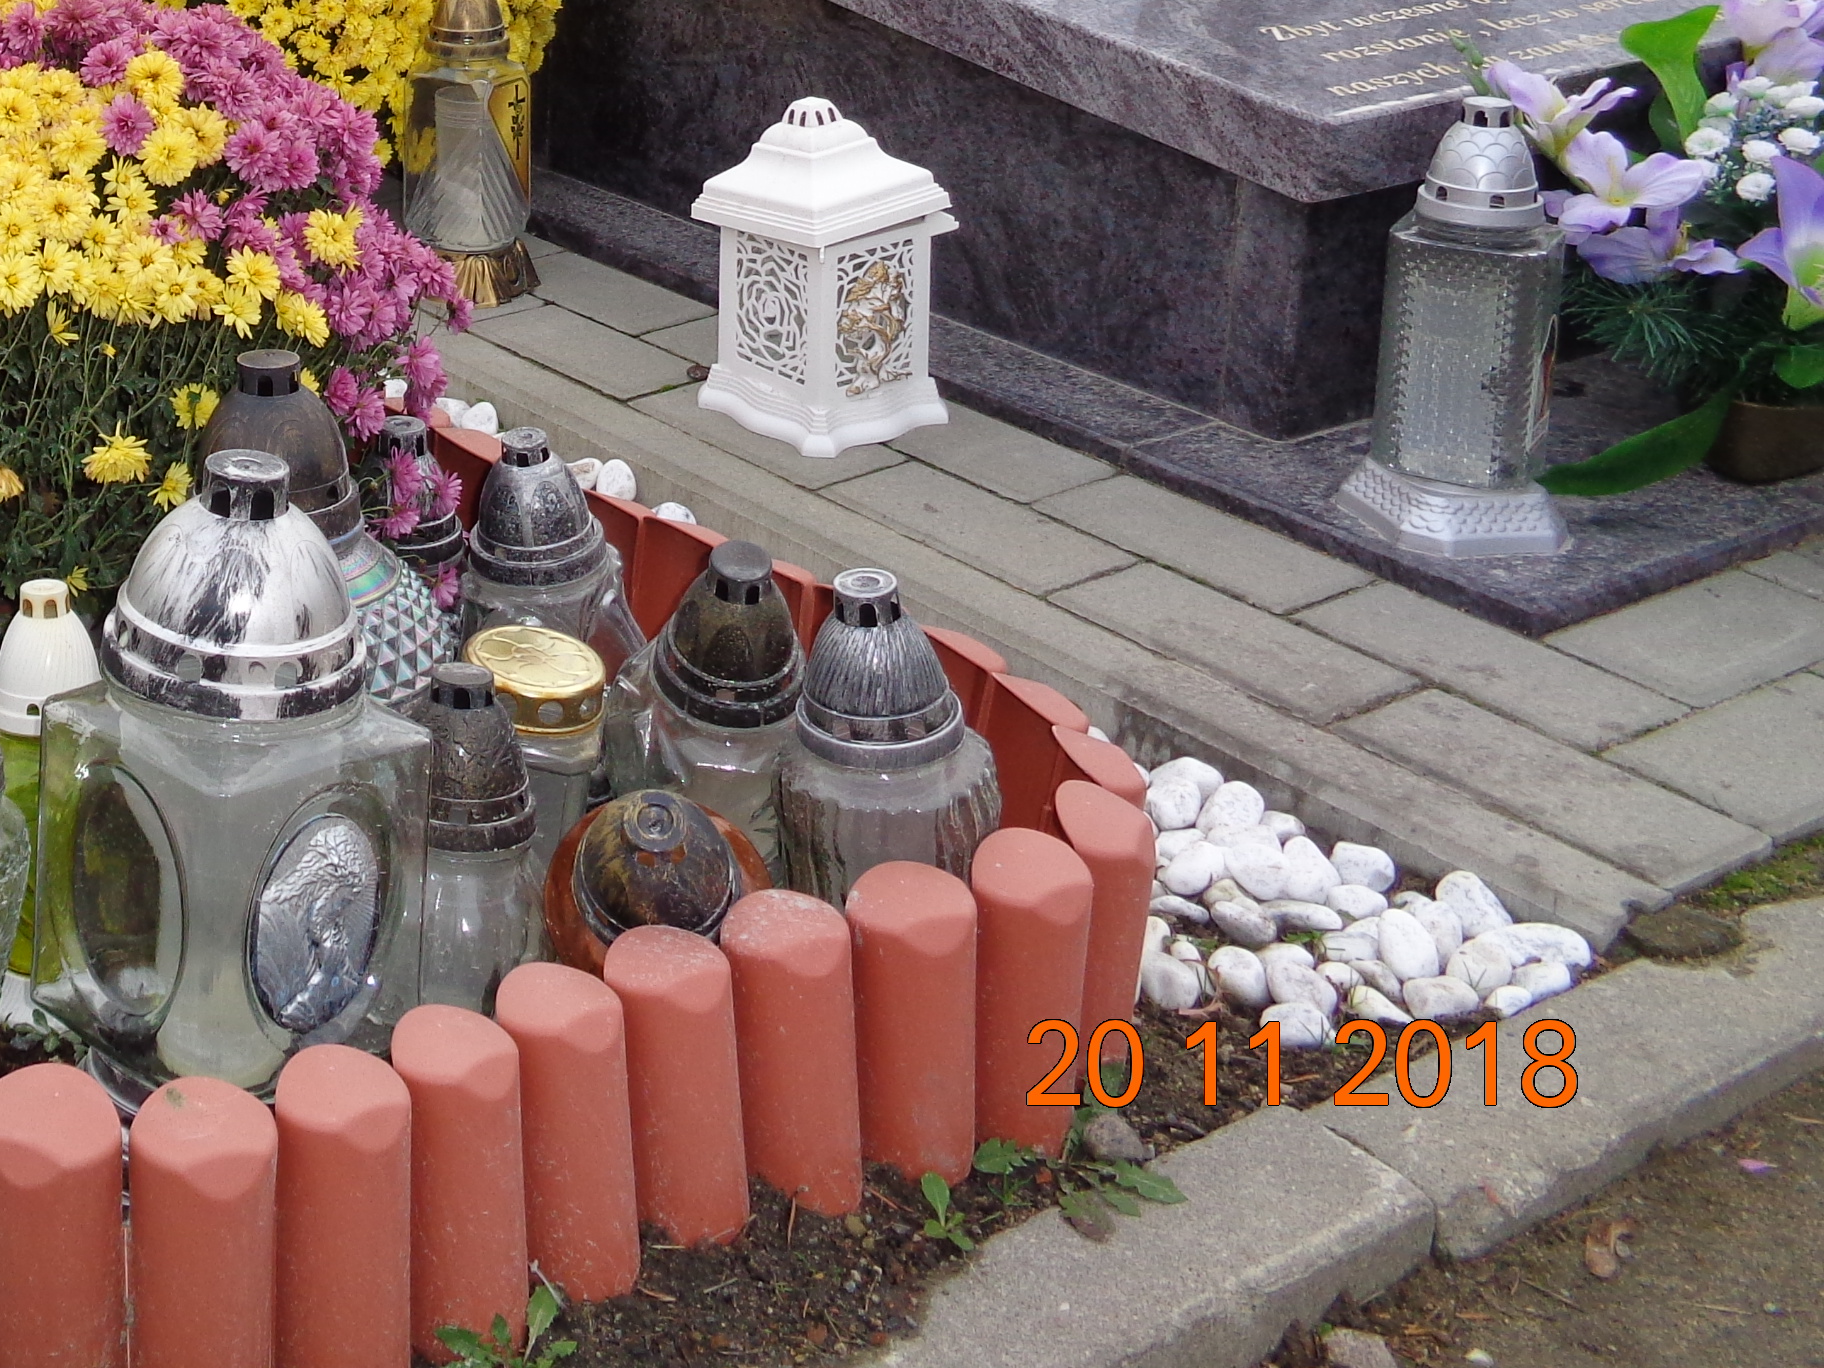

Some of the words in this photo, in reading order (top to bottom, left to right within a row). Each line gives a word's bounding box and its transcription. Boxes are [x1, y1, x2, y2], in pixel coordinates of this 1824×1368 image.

[1259, 20, 1343, 42] Zbyt
[1320, 27, 1471, 63] rozstanie
[1477, 13, 1552, 31] lecz
[1548, 9, 1579, 20] w
[1327, 62, 1461, 97] naszych
